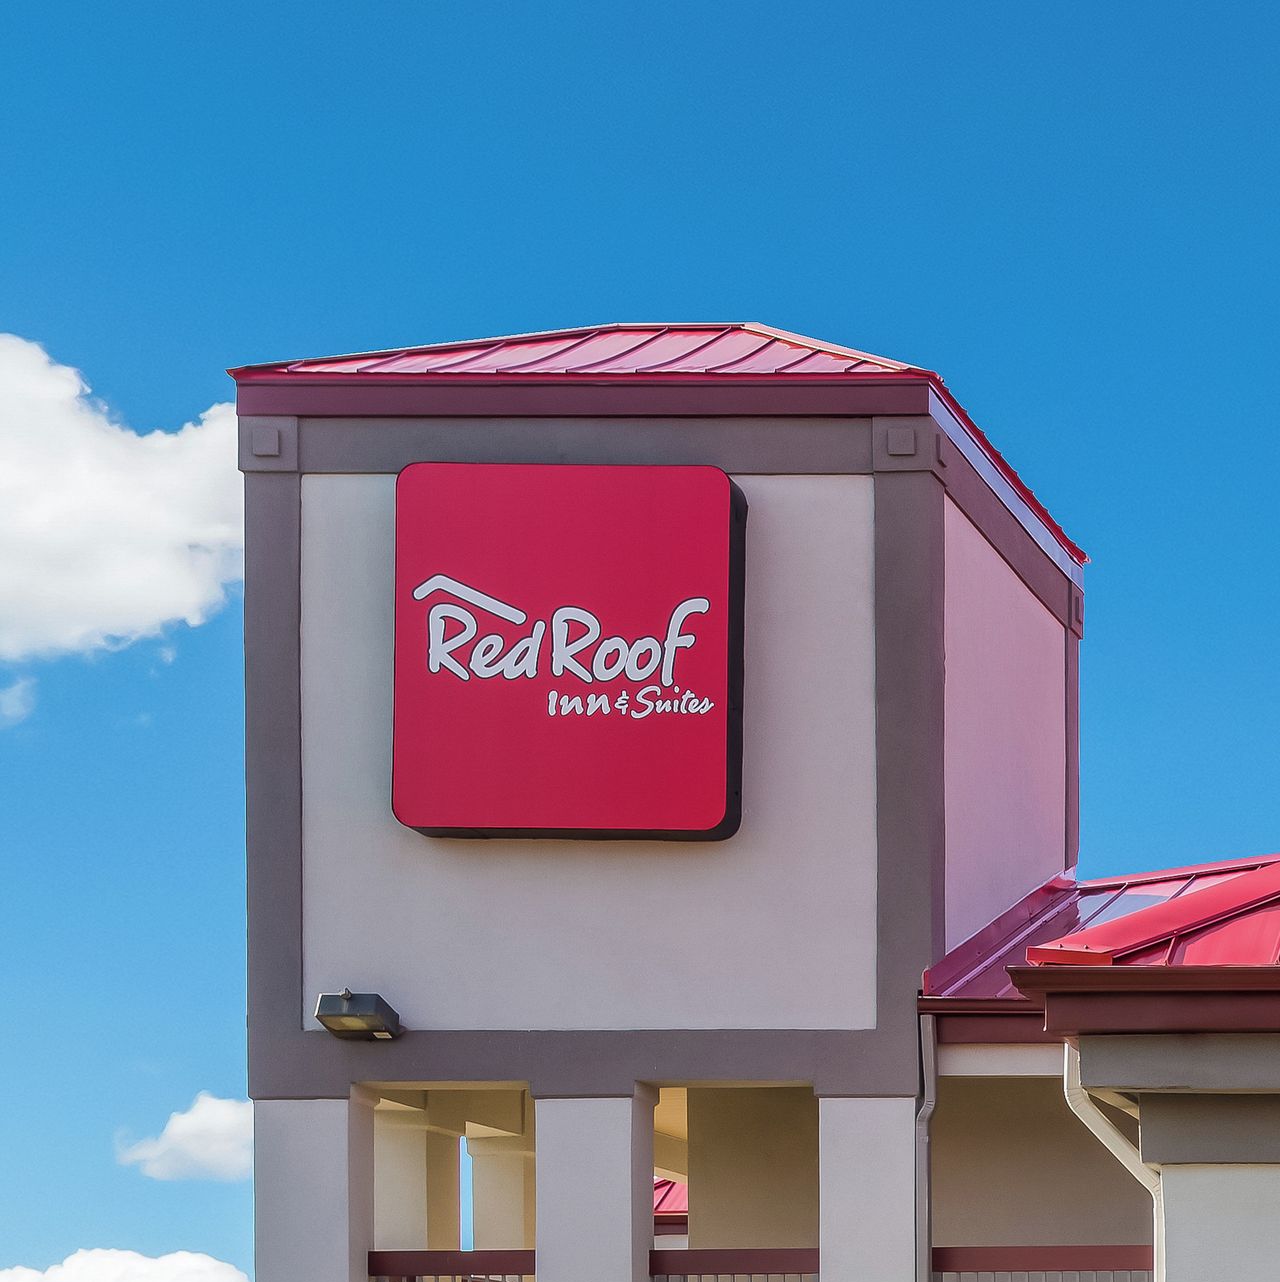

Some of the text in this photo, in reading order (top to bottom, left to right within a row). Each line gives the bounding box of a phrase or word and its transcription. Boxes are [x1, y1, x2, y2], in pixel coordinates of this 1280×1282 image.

[428, 598, 711, 687] Red Roof
[548, 686, 715, 719] Inn & Suites
